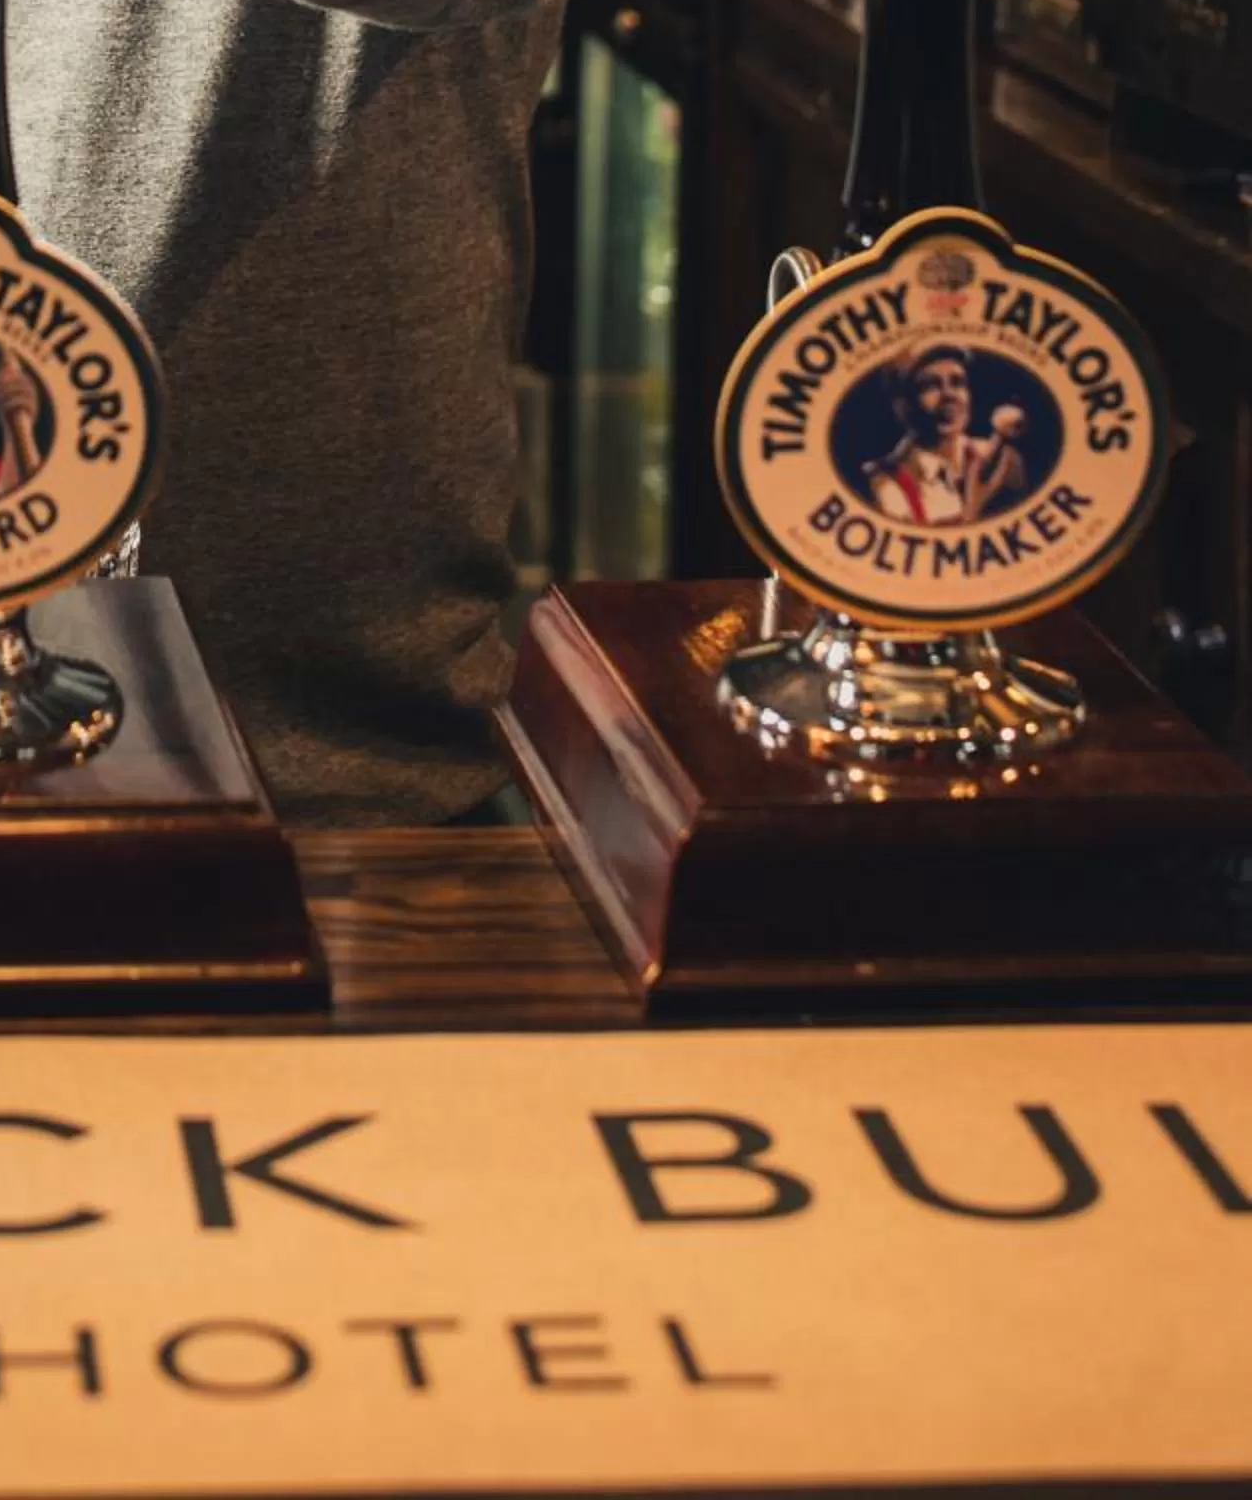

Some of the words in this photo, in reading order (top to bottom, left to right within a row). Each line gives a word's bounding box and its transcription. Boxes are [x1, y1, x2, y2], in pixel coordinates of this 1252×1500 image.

[761, 282, 910, 462] TIMOTHY
[982, 280, 1138, 457] TAYLOR'S
[807, 484, 1093, 579] BOLTMAKER
